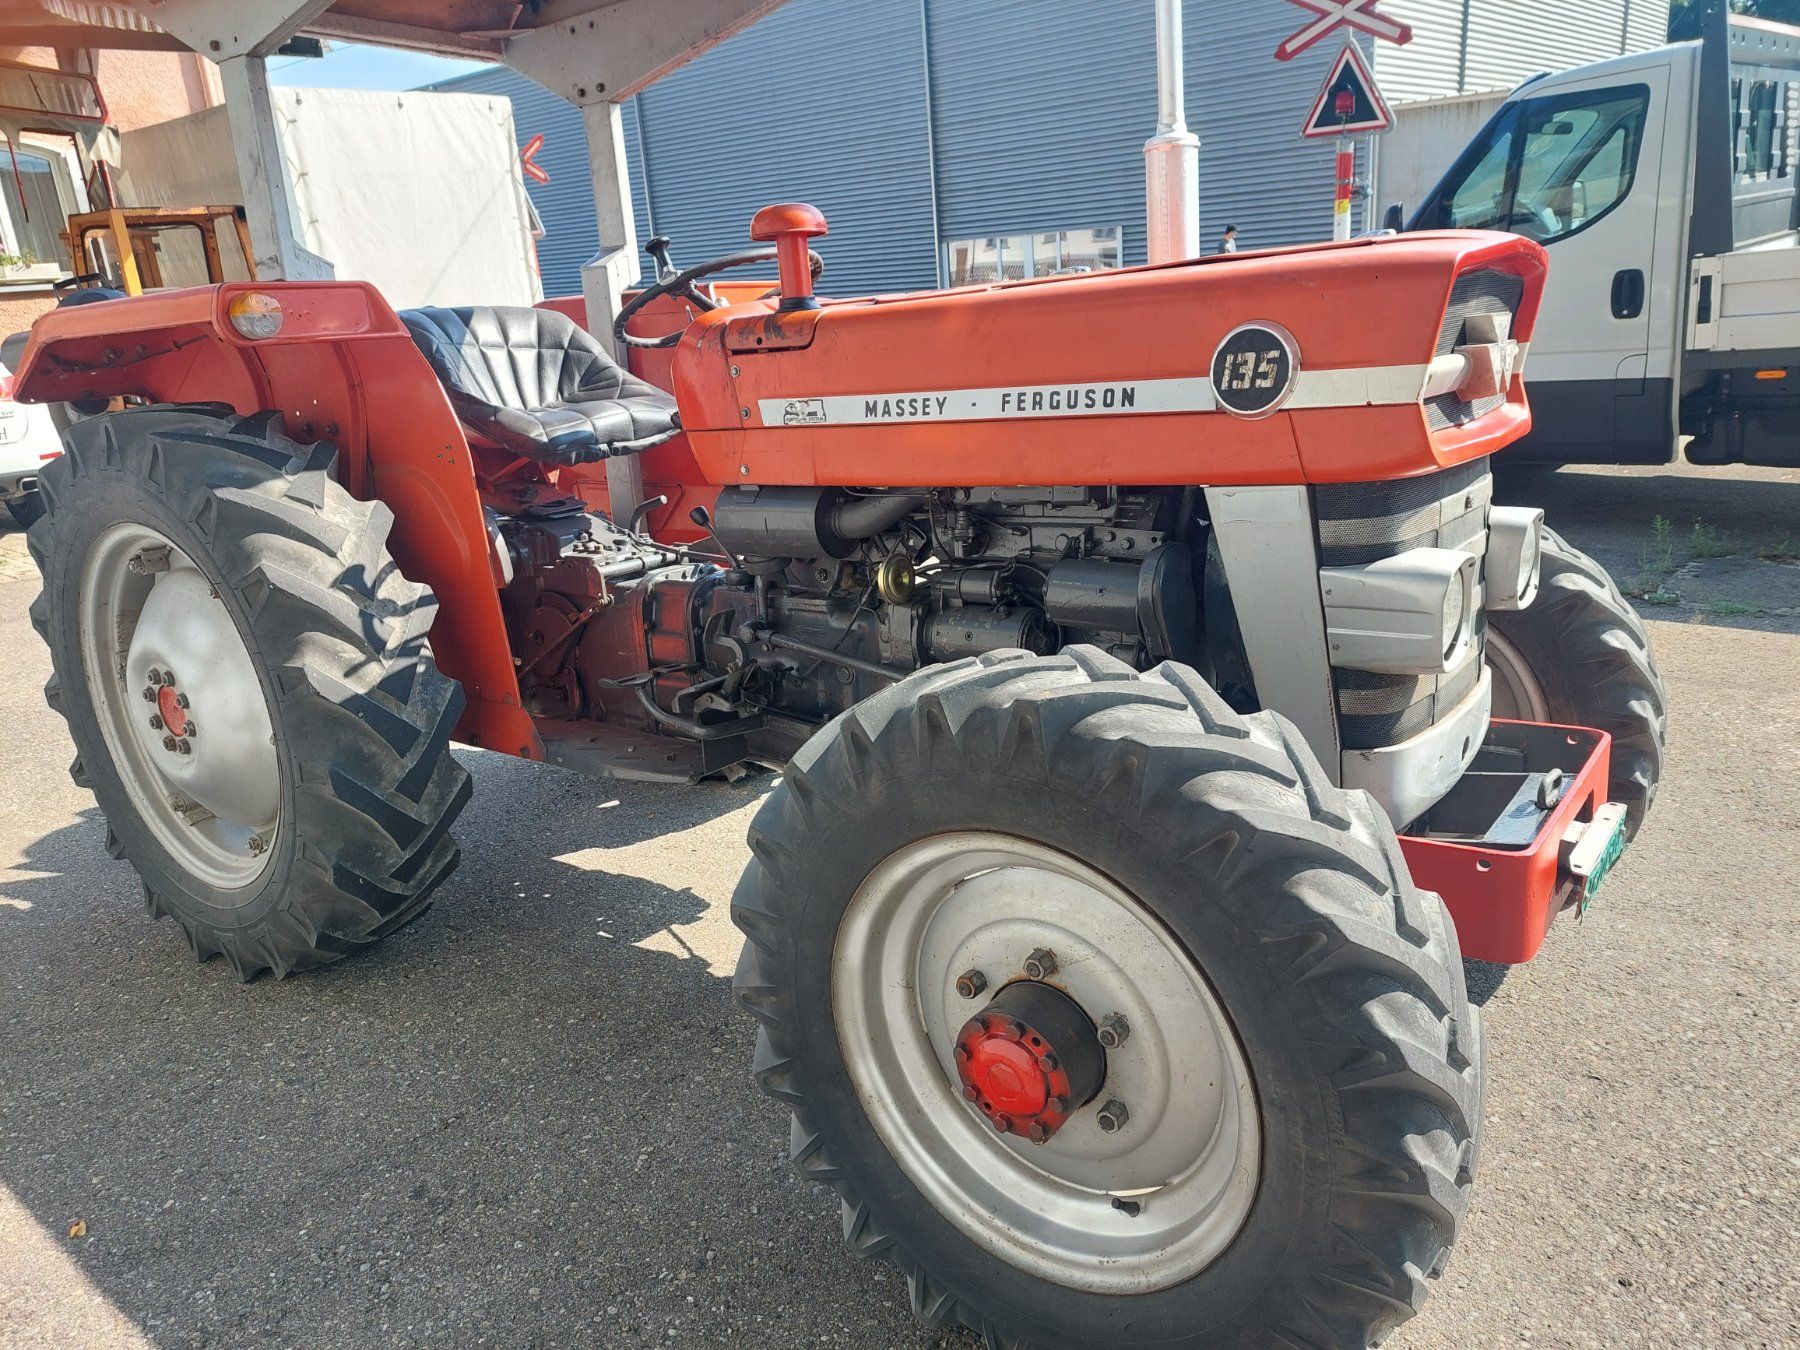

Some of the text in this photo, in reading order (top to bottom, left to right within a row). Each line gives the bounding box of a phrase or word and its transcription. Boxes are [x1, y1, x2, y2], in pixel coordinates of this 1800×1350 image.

[1221, 350, 1280, 390] 135
[865, 397, 947, 418] MASSEY
[1001, 387, 1135, 412] FERGUSON
